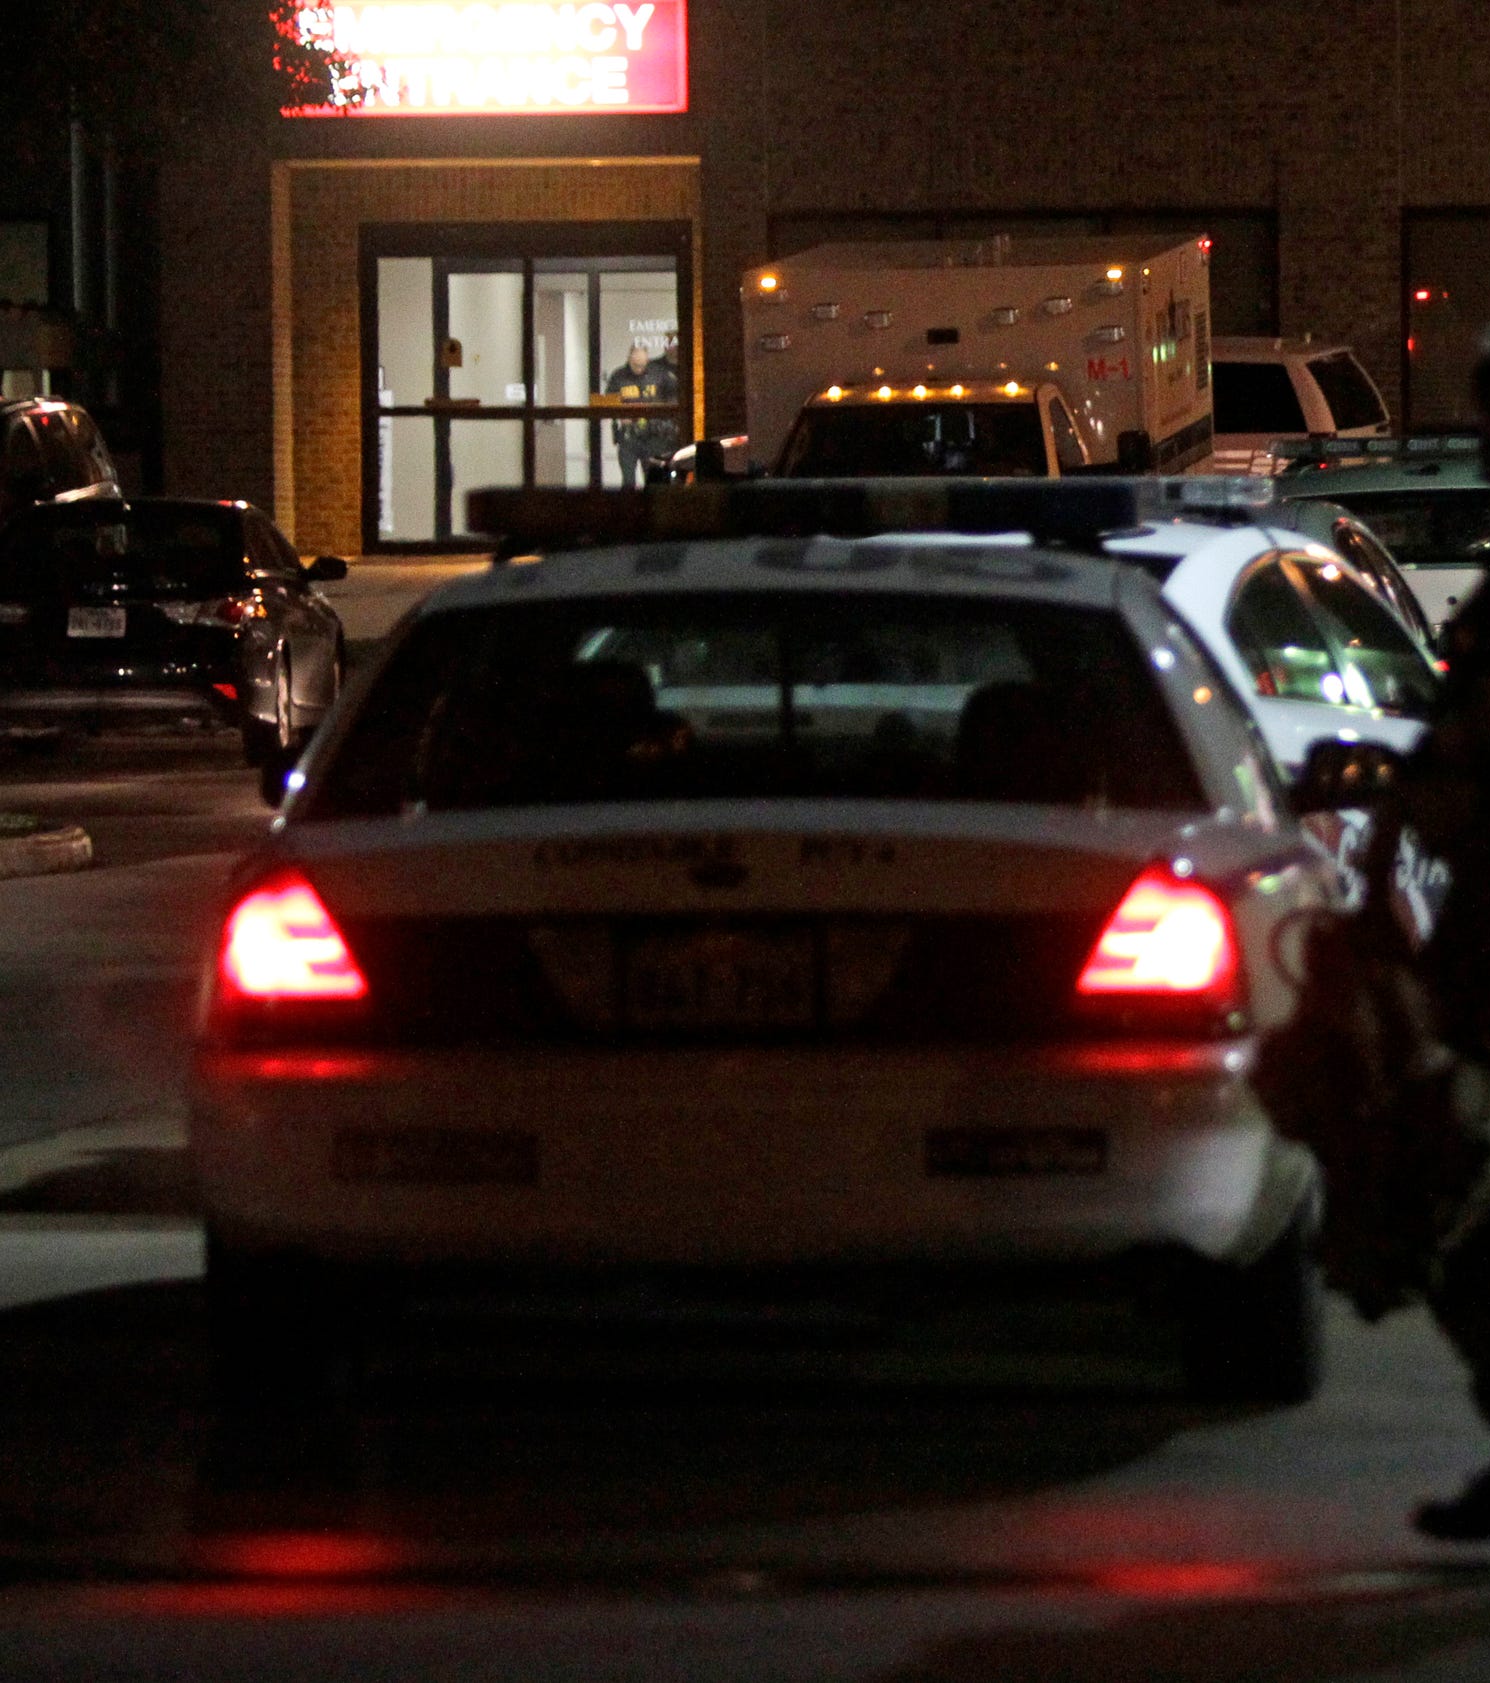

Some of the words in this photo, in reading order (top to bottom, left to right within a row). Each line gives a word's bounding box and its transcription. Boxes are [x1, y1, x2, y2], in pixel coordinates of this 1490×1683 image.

[299, 3, 655, 53] EMERGENCY
[329, 56, 630, 107] ENTRANCE
[1087, 358, 1130, 380] M-1
